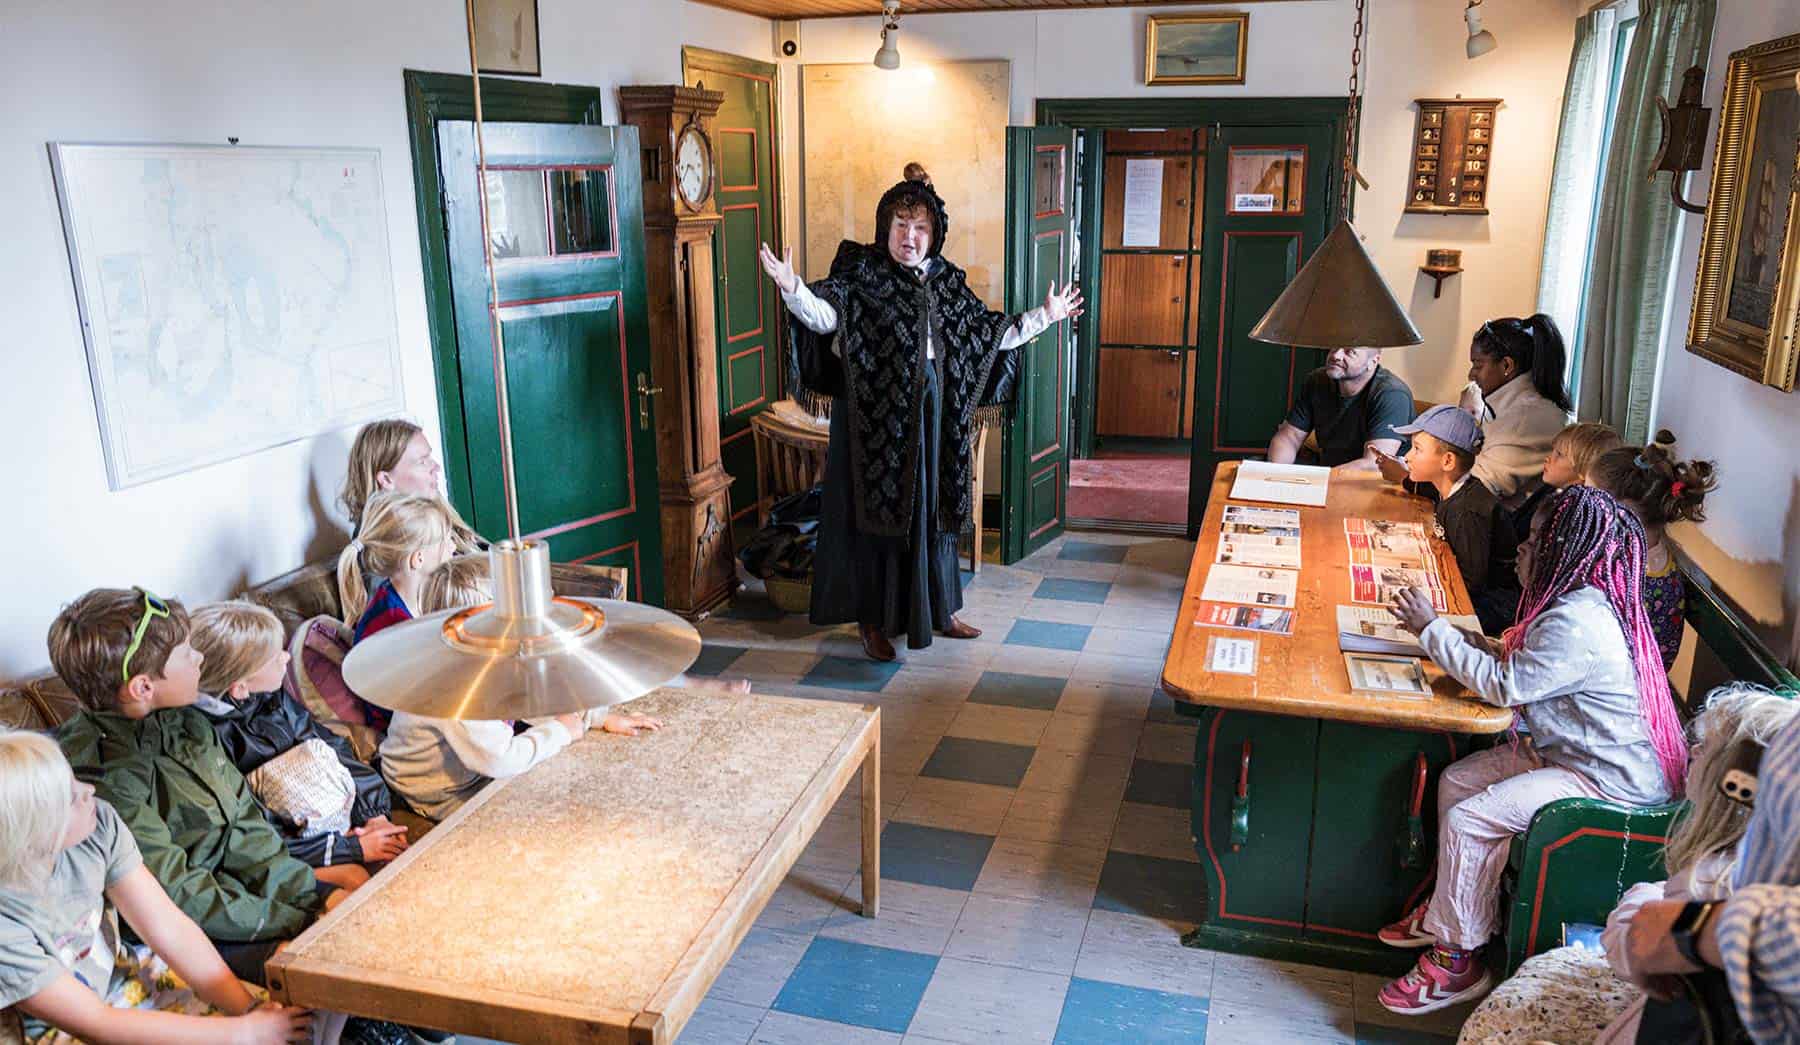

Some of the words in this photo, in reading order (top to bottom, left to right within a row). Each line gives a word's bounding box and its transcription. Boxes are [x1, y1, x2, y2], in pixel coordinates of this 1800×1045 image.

[1431, 113, 1437, 123] 1
[1475, 113, 1483, 122] 7
[1423, 129, 1432, 140] 2
[1473, 128, 1481, 137] 8
[1476, 145, 1484, 155] 9
[1467, 160, 1480, 170] 10
[1419, 175, 1427, 186] 5
[1450, 177, 1456, 186] 1
[1416, 190, 1424, 201] 6
[1448, 192, 1456, 202] 2
